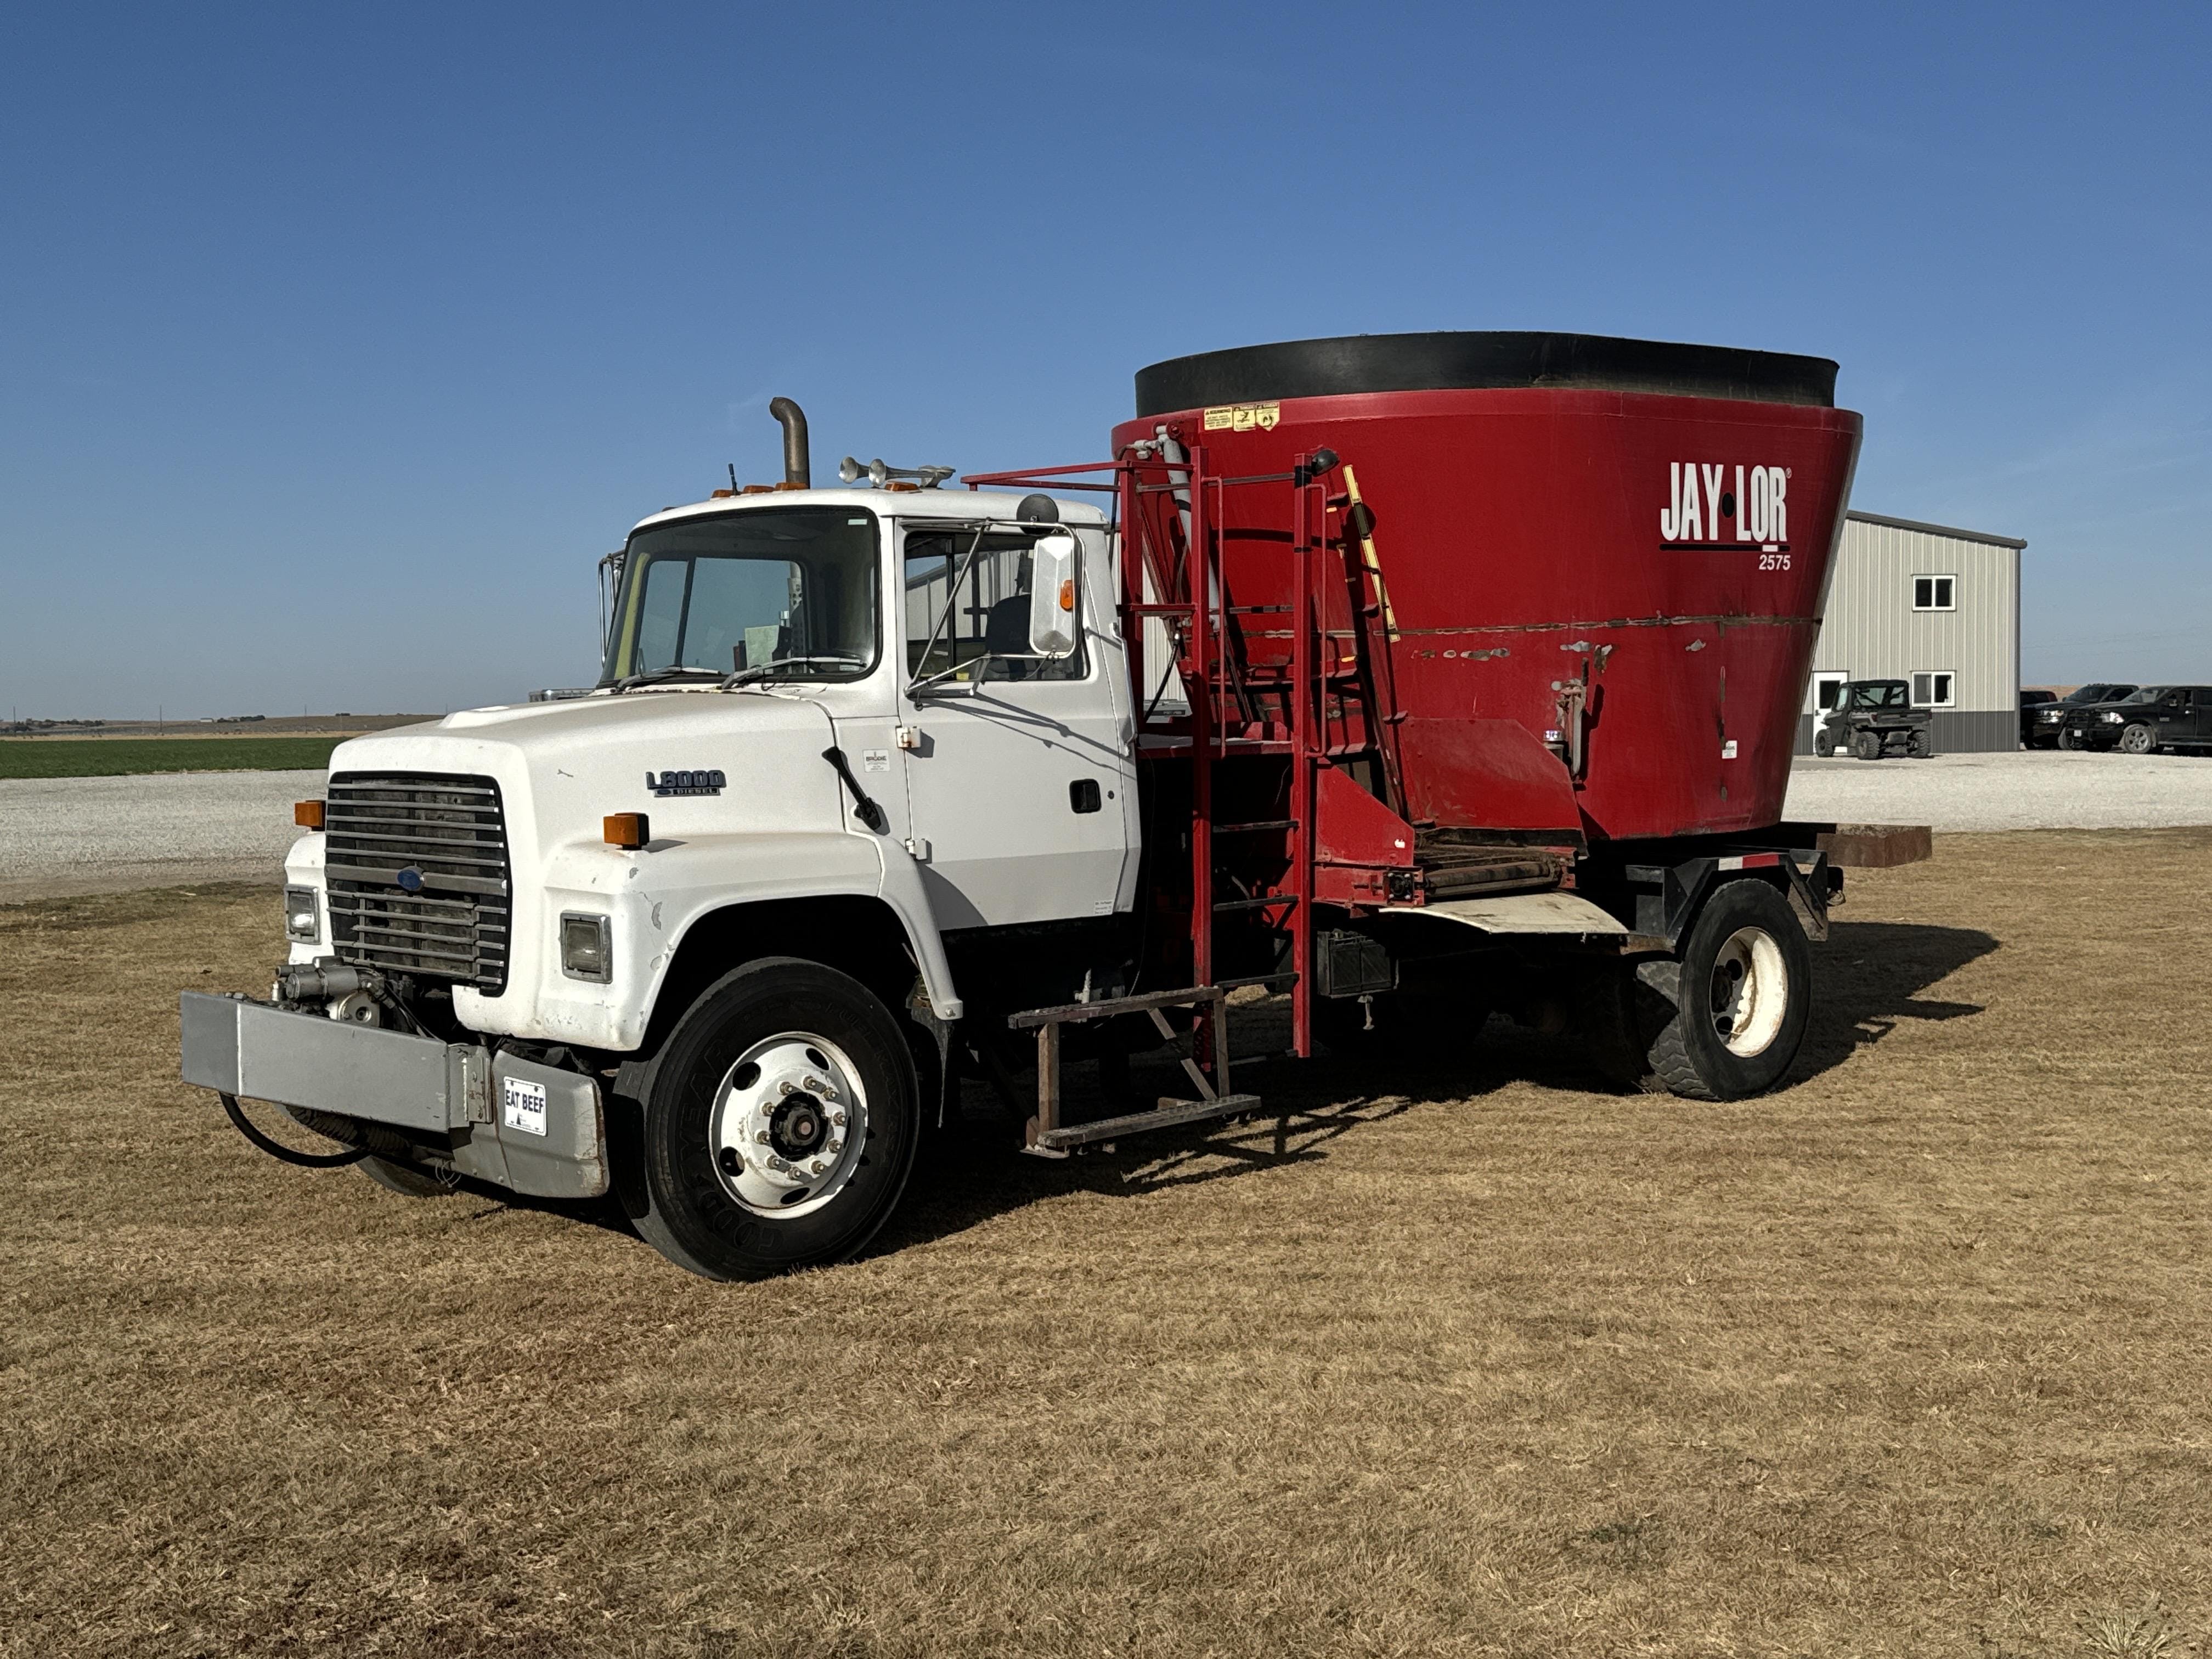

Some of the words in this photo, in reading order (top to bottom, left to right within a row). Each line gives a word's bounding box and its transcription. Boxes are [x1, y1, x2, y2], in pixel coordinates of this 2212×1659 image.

[1758, 554, 1791, 571] 2575
[646, 770, 726, 790] L8000
[506, 1090, 520, 1108] EAT
[522, 1093, 544, 1114] BEEF
[679, 1037, 784, 1254] GOODYEAR
